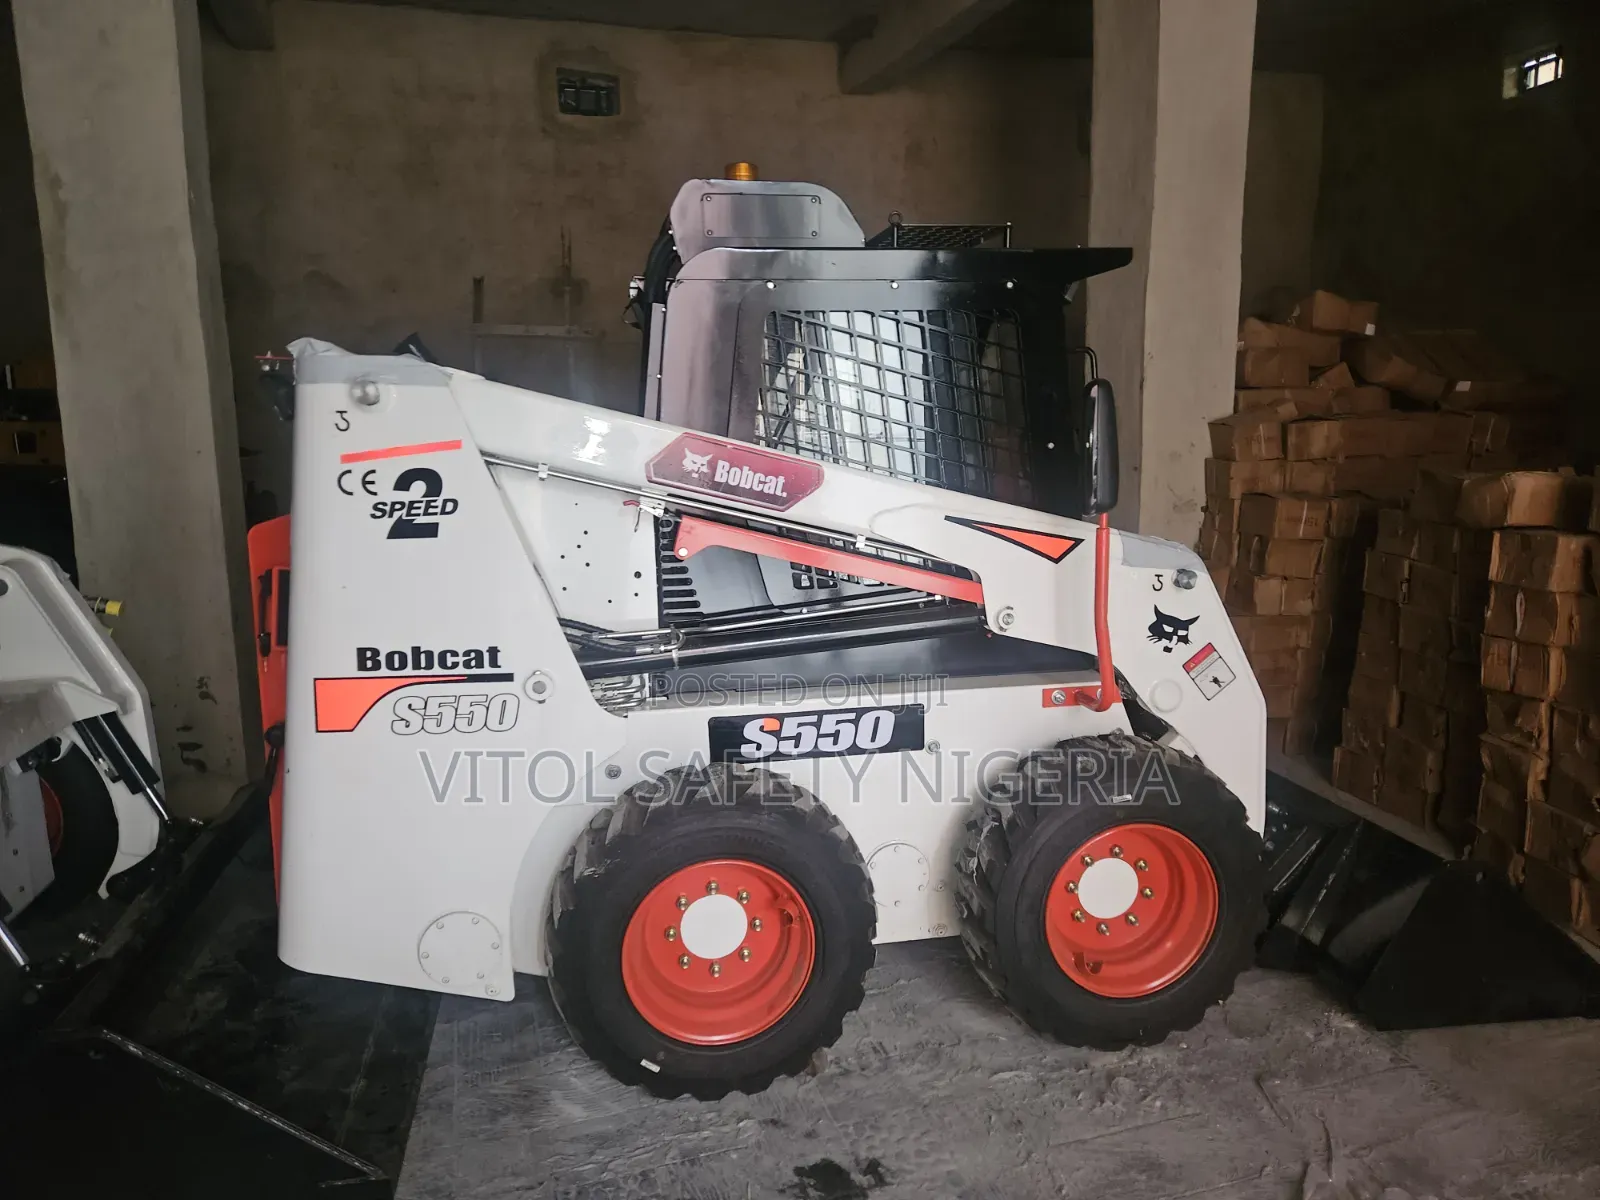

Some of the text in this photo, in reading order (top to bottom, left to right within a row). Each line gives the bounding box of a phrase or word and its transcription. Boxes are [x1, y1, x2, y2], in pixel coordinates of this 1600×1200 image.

[337, 469, 378, 496] CE
[370, 498, 459, 520] SPEED
[386, 467, 443, 539] 2
[356, 646, 502, 673] Bobcat
[391, 693, 520, 736] S550
[741, 710, 895, 760] S550
